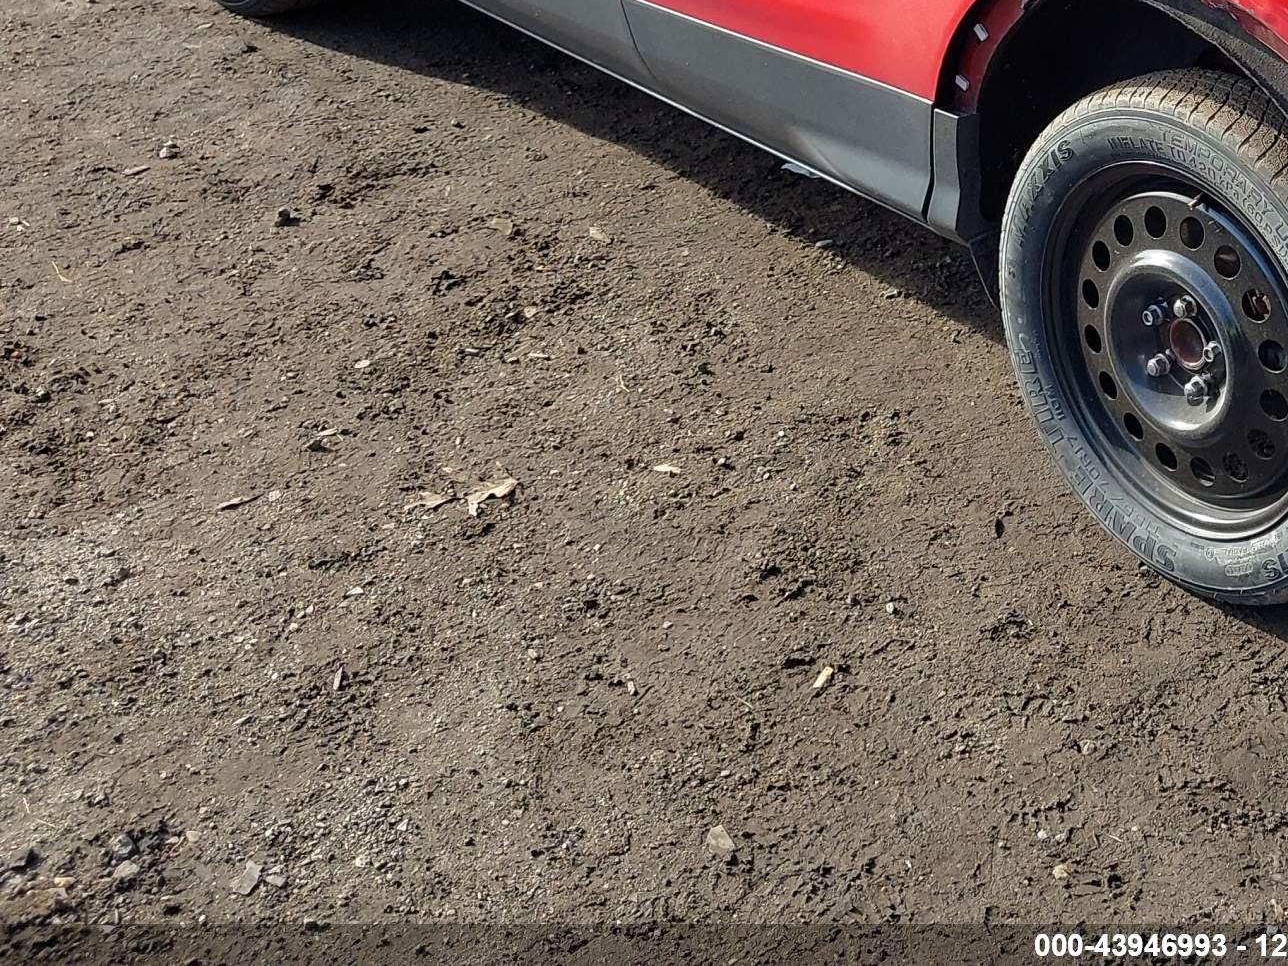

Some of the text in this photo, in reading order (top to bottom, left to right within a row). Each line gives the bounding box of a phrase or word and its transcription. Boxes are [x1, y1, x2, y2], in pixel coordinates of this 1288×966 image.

[1012, 138, 1076, 250] MAXXIS
[1107, 135, 1164, 155] INFLATE
[1159, 128, 1275, 221] TEMPORARY
[1015, 349, 1176, 573] SPARE TIRE
